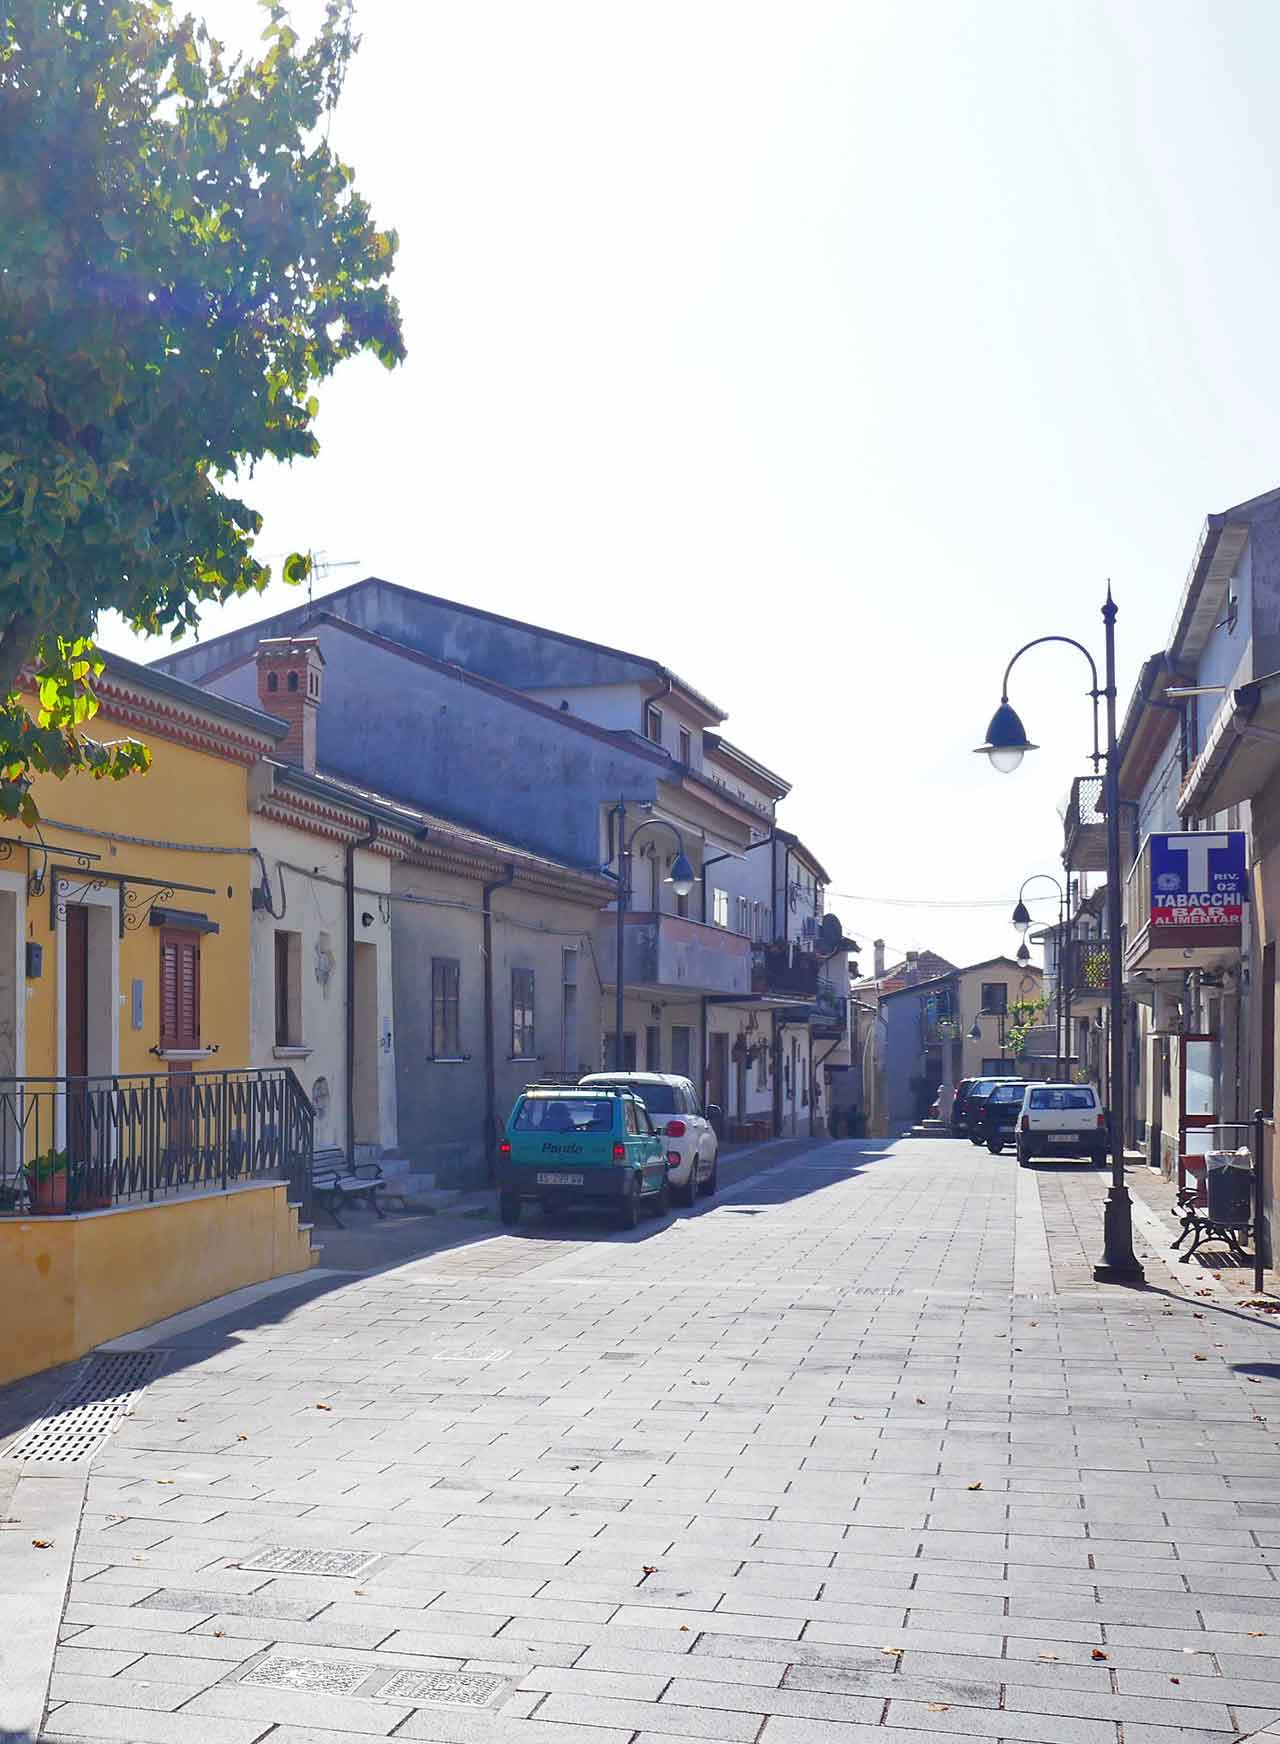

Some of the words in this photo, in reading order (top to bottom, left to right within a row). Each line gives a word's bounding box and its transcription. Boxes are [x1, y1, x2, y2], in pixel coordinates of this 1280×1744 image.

[1167, 835, 1228, 893] T
[1154, 893, 1240, 907] TABACCHI
[1172, 907, 1224, 916] BAR
[542, 1142, 584, 1153] Panda
